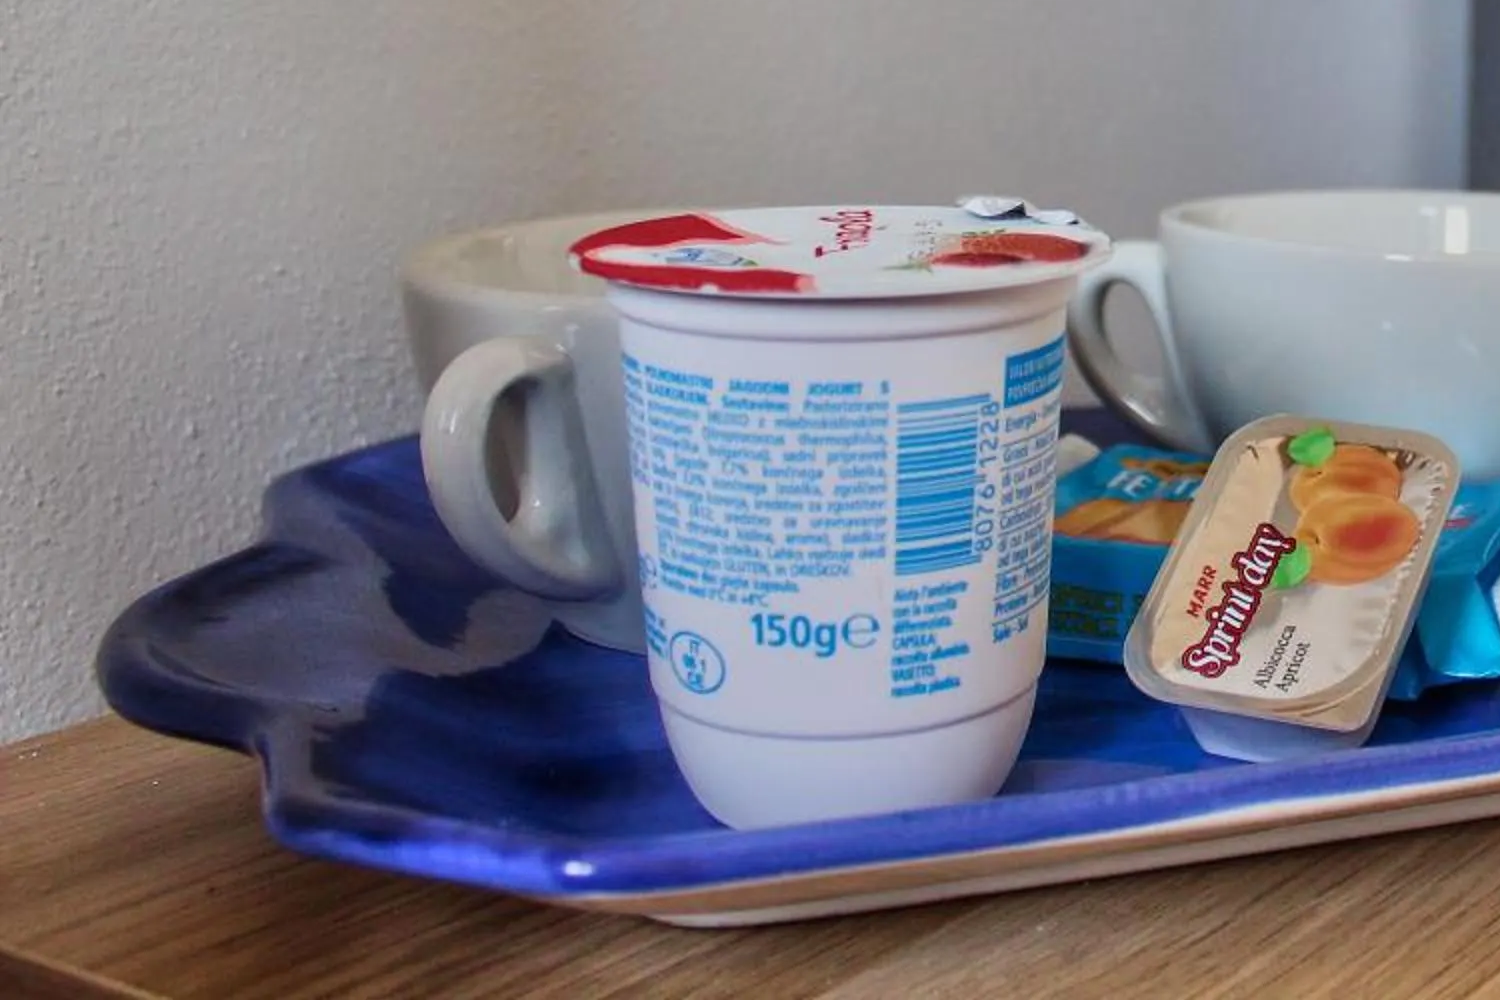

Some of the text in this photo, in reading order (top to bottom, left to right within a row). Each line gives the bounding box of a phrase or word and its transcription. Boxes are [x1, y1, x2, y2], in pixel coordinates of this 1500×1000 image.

[1186, 565, 1217, 618] MARR
[751, 612, 838, 659] 150g
[1253, 625, 1297, 689] Albicocca
[1275, 642, 1311, 693] Apricot
